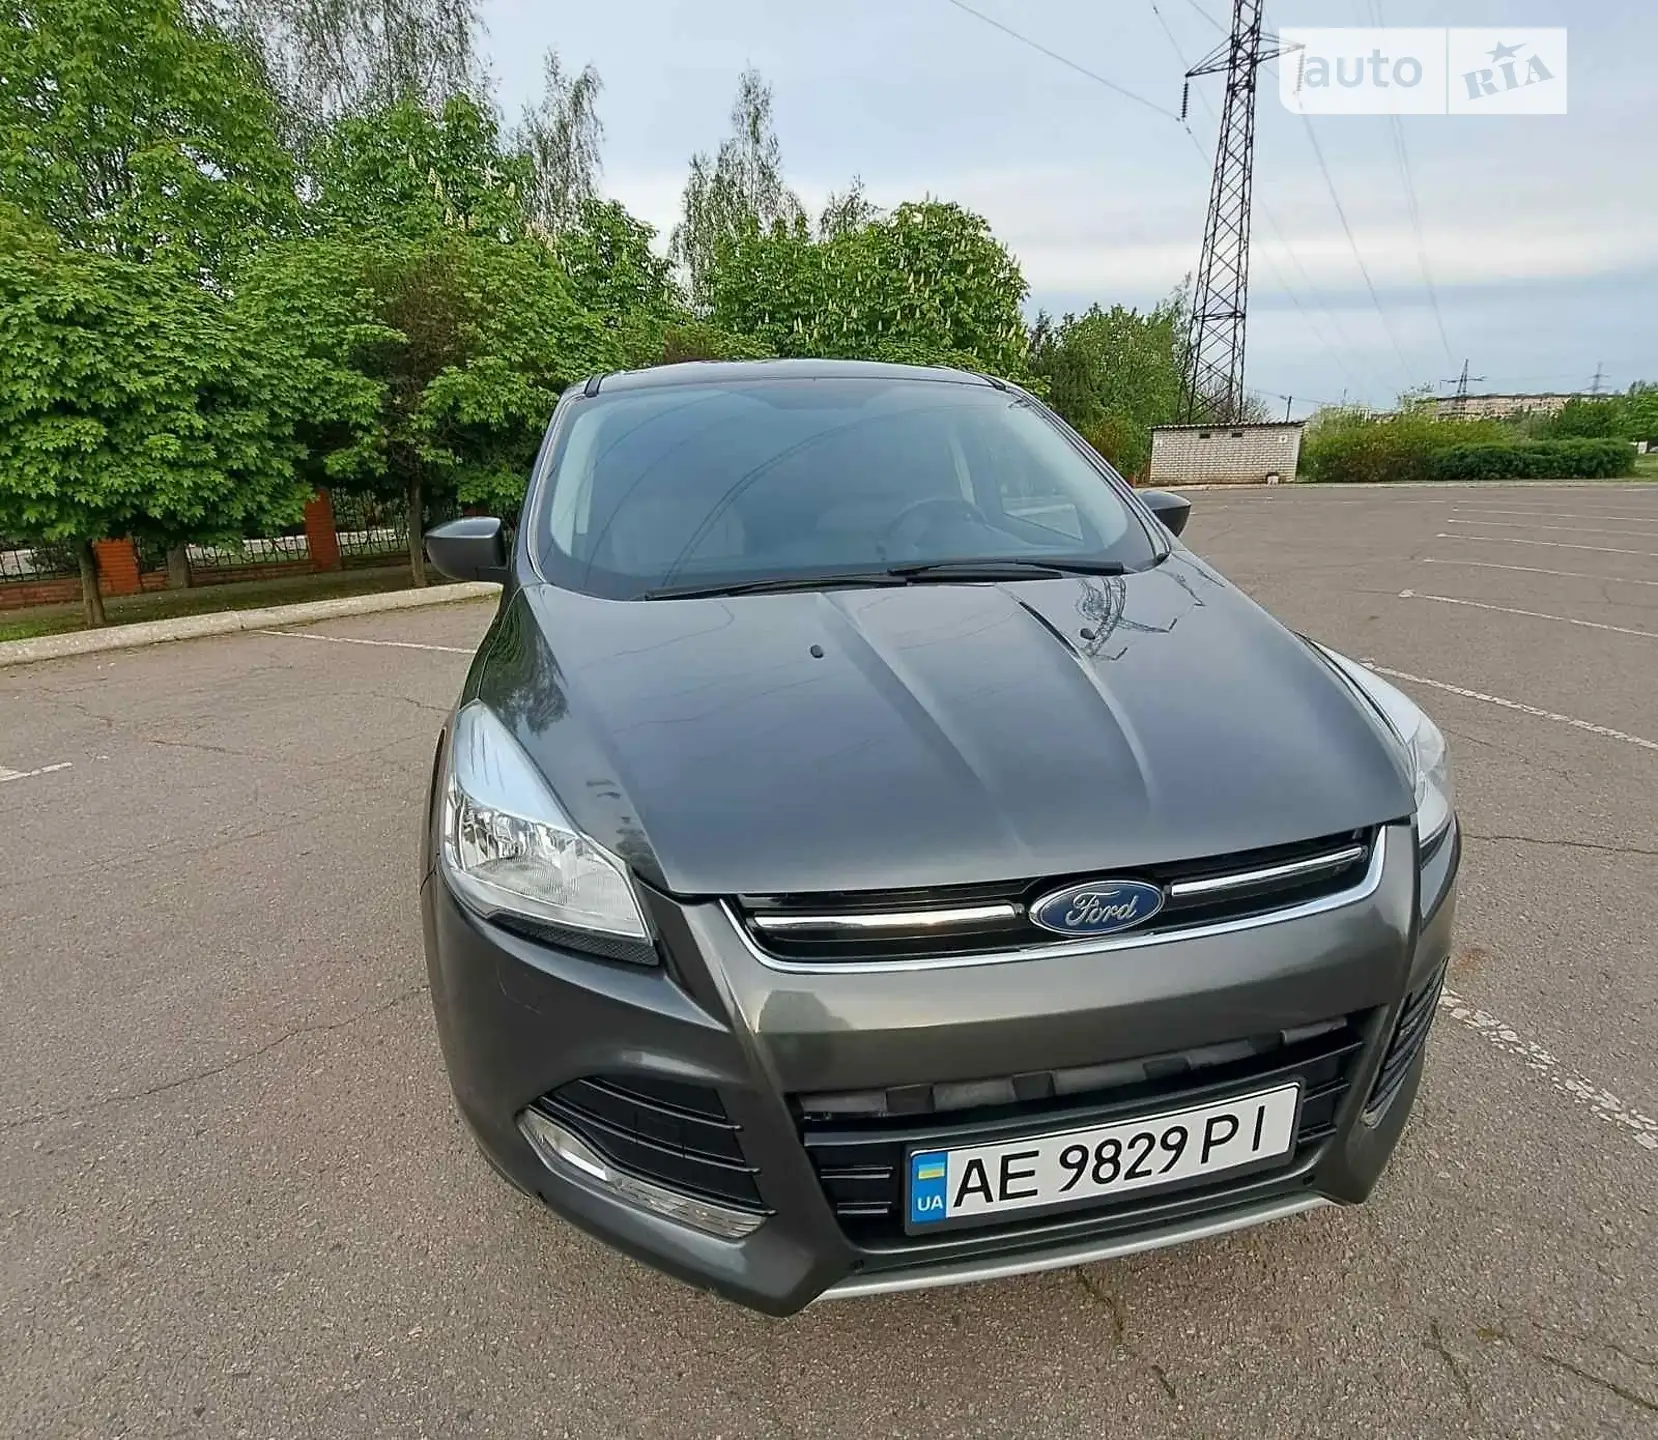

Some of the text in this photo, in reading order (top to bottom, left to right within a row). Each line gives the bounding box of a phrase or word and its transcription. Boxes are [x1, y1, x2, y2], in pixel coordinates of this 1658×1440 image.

[1065, 890, 1139, 926] Ford
[953, 1105, 1266, 1208] AE 9829 PI
[917, 1195, 943, 1212] UA
